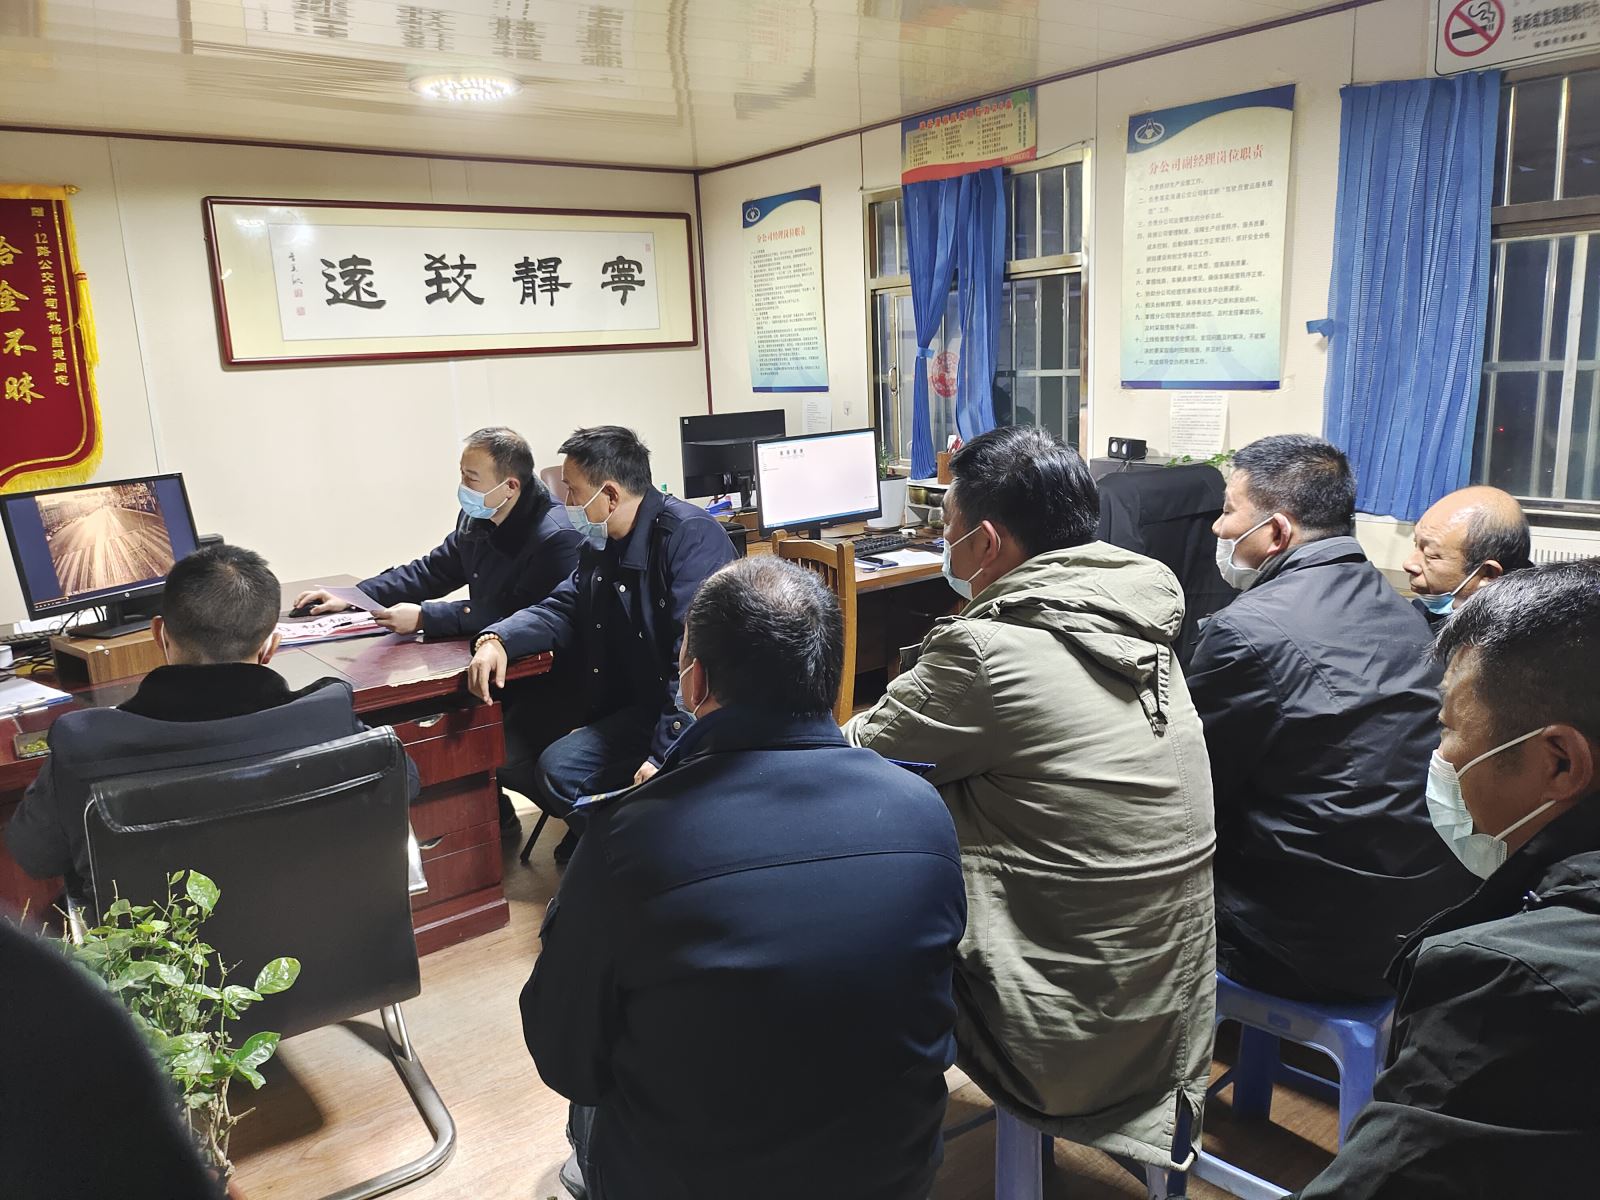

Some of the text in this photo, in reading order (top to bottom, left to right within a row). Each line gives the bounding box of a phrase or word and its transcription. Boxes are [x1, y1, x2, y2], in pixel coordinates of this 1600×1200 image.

[1149, 144, 1264, 175] 分公司副经理岗位职责
